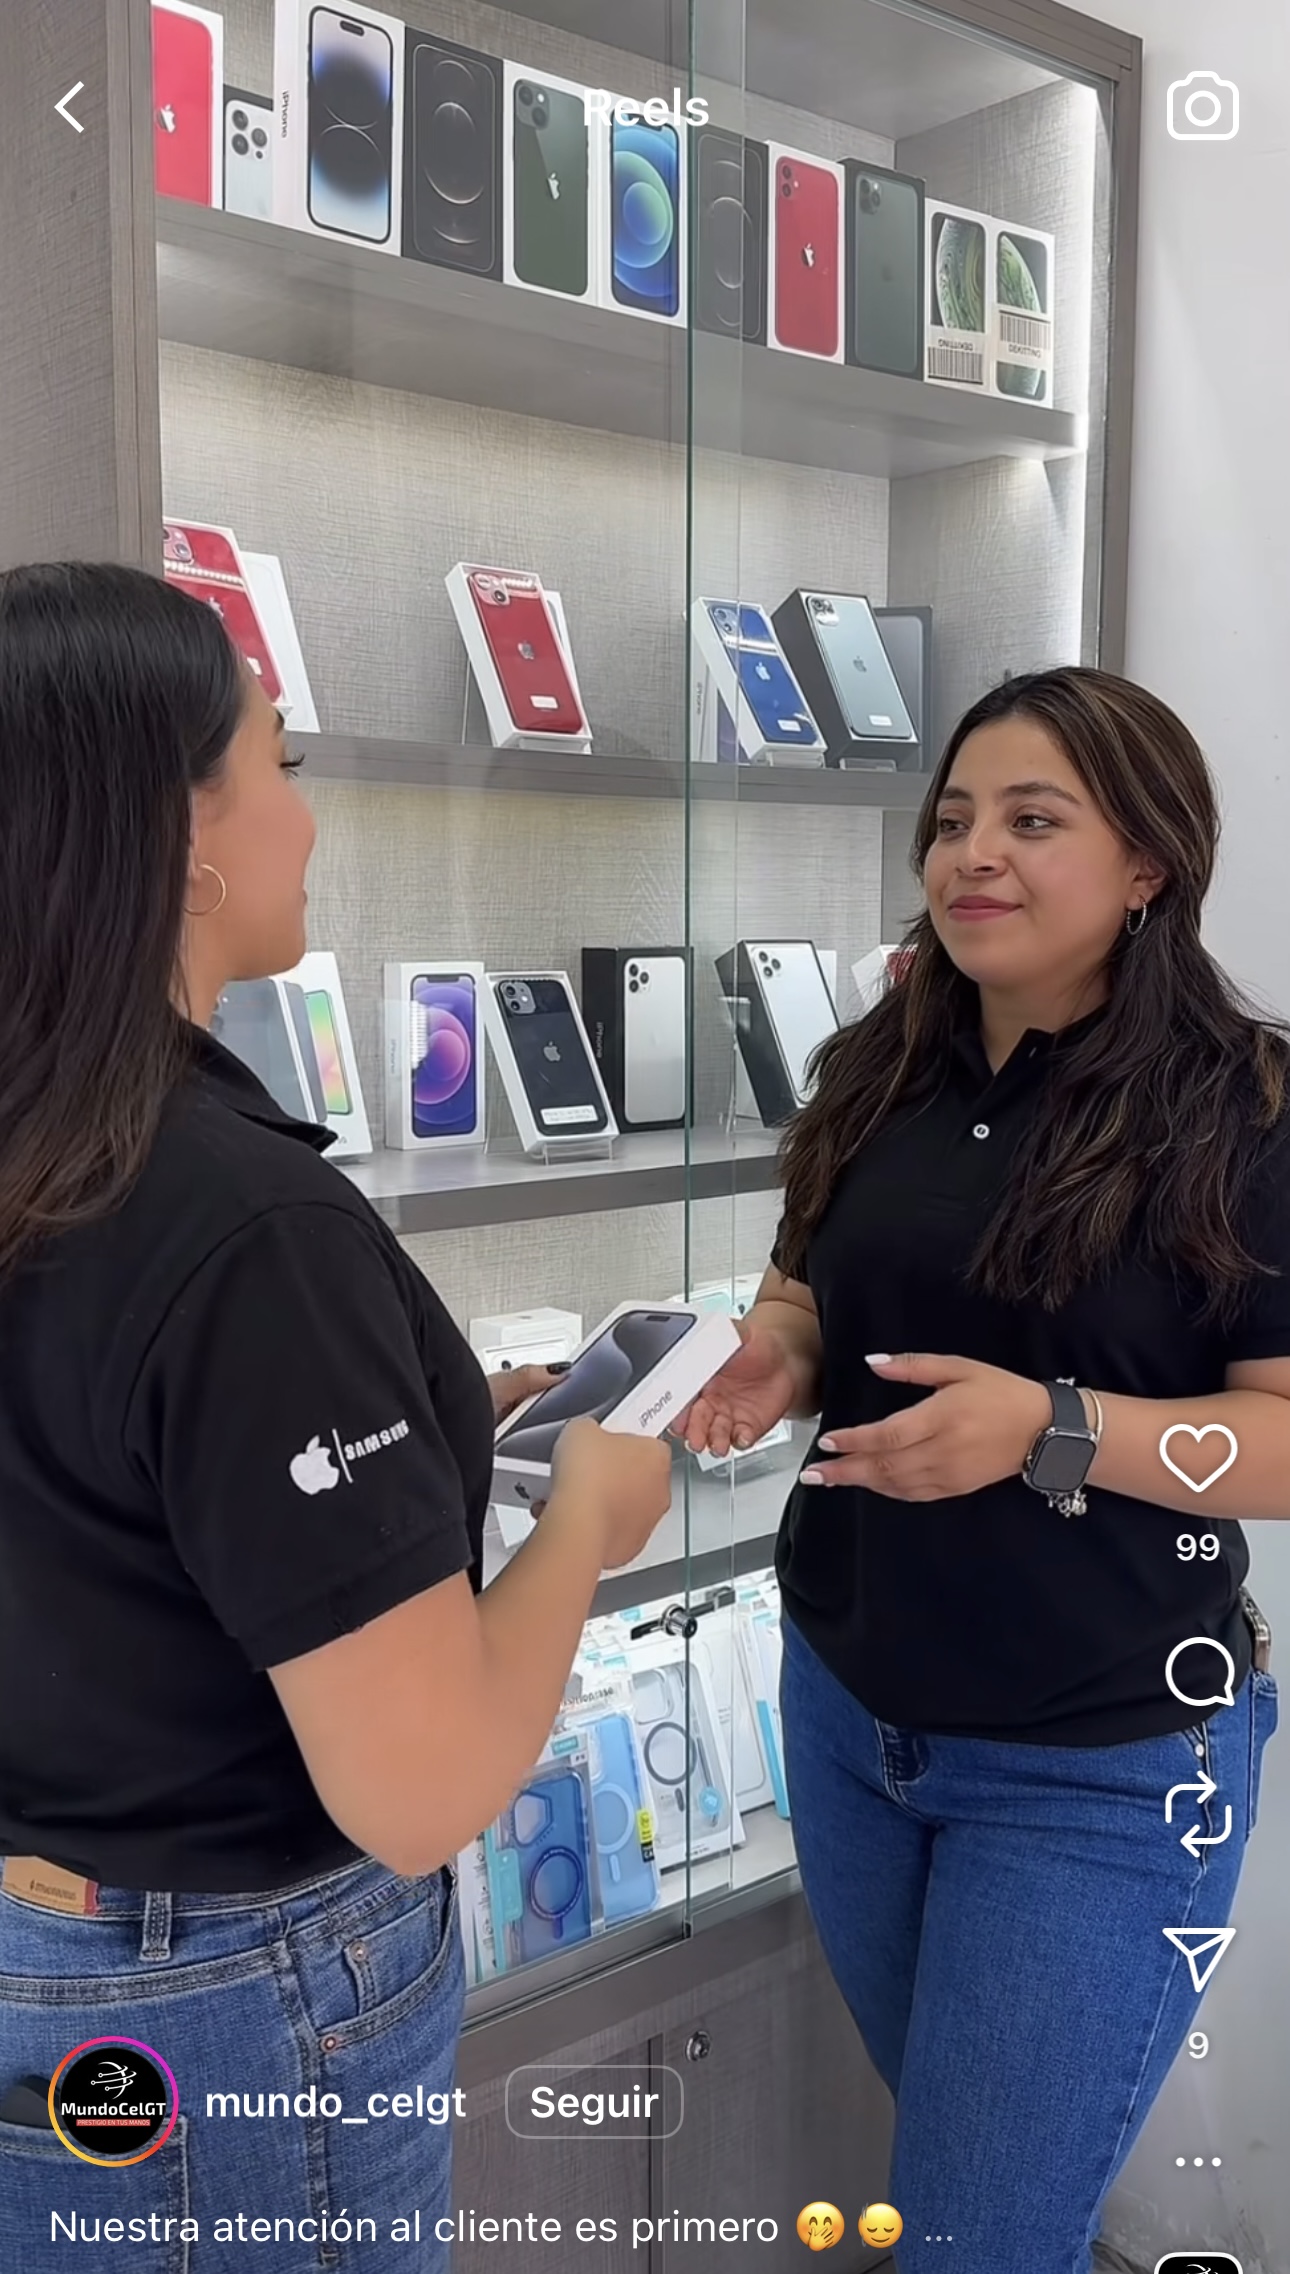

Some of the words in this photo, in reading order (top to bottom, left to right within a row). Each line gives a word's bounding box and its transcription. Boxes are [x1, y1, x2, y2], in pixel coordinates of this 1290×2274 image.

[281, 90, 289, 138] iPhone
[1008, 343, 1041, 358] DEKITTING
[638, 1390, 673, 1428] iPhone
